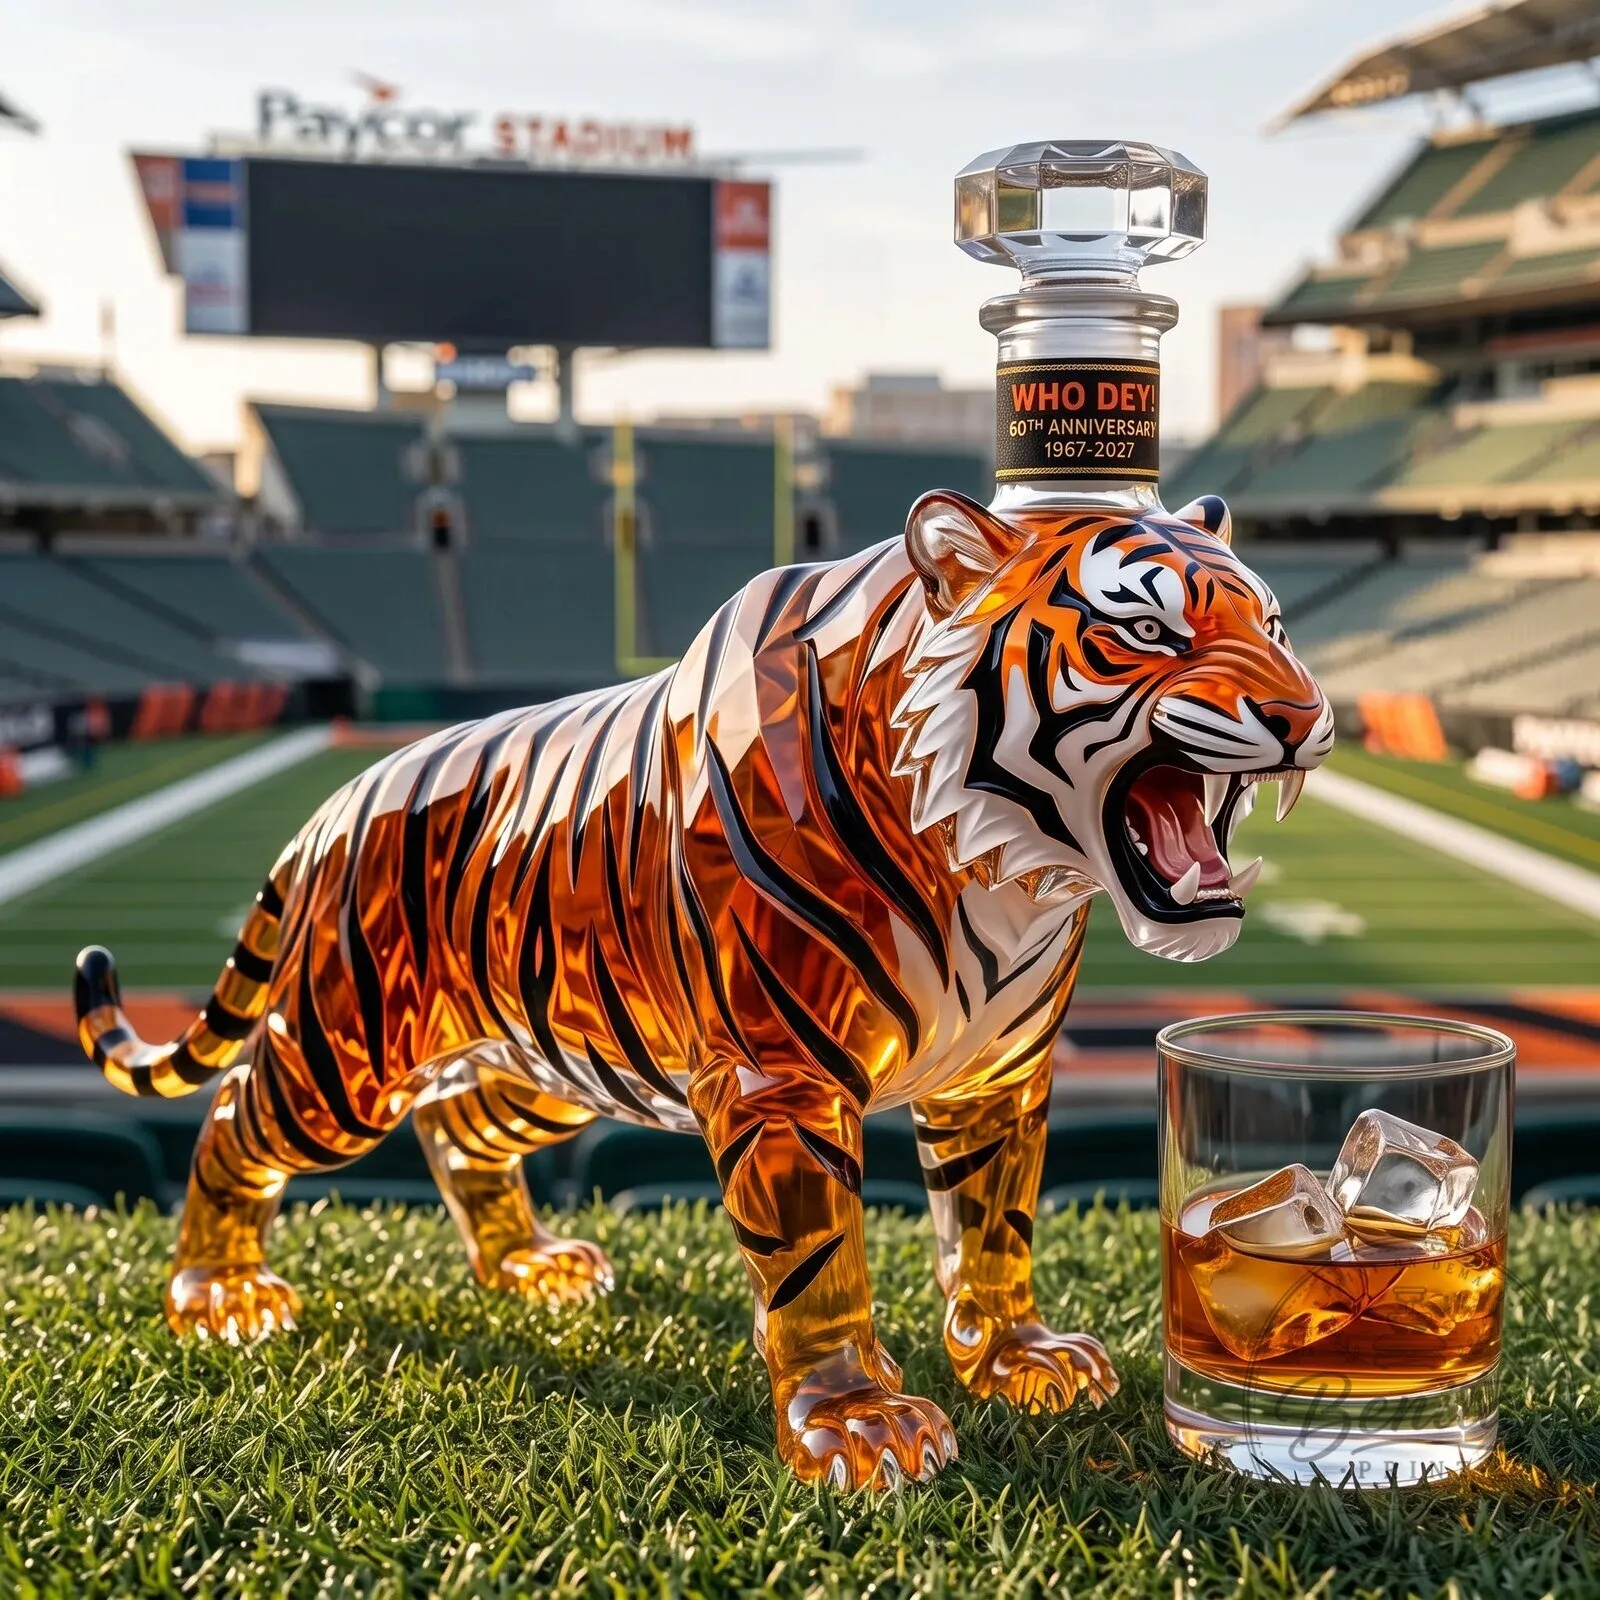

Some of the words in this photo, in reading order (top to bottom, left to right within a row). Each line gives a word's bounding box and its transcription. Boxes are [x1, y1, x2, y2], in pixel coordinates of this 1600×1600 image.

[494, 113, 694, 159] STADIUM
[1011, 381, 1085, 412] WHO
[1097, 381, 1155, 412] DEY!
[1009, 419, 1043, 437] 60TH
[1048, 418, 1157, 438] ANNIVERSARY
[1044, 441, 1135, 459] 1967-2027
